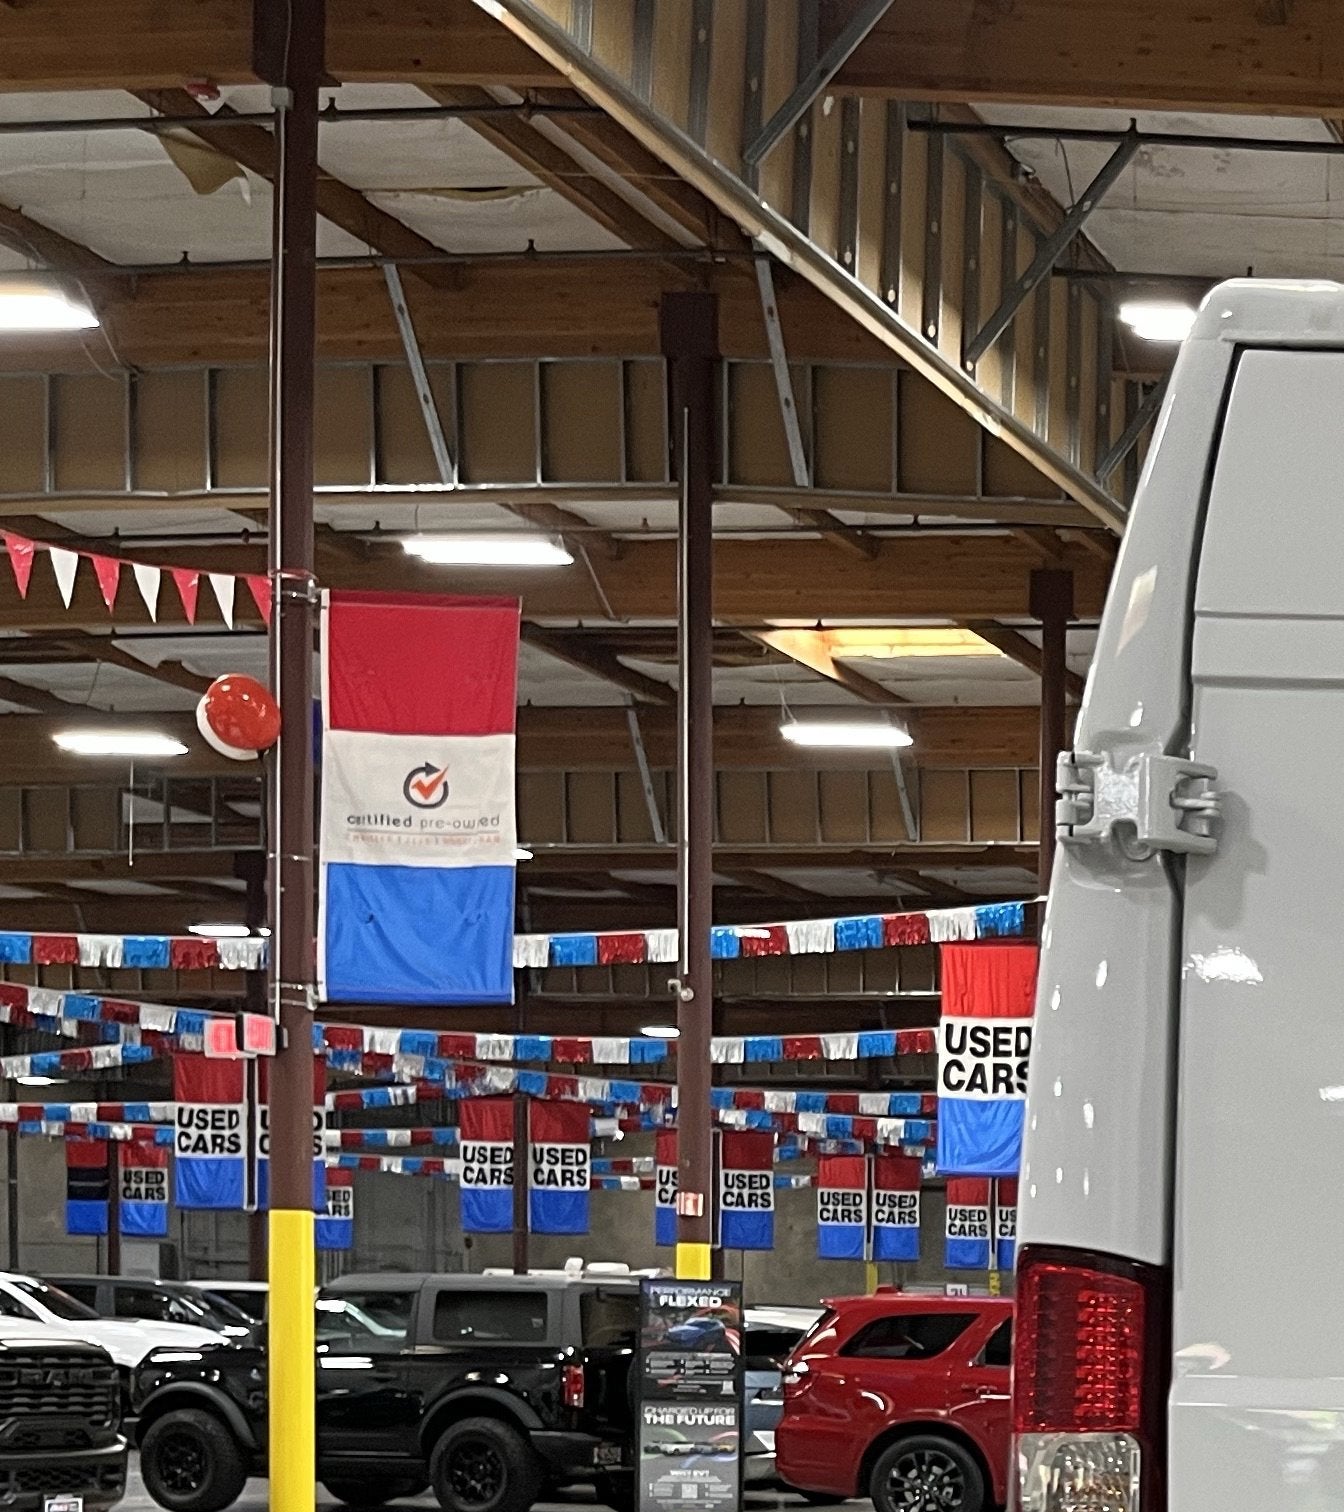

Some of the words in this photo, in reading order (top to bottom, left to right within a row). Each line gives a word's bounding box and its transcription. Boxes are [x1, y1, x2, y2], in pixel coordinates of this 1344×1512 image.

[421, 815, 500, 829] pre-owed
[945, 1023, 1032, 1058] USED
[943, 1059, 1029, 1094] CARS
[178, 1106, 240, 1130] USED
[260, 1109, 323, 1131] UD
[177, 1131, 242, 1154] CARS
[259, 1134, 323, 1156] CS
[463, 1145, 514, 1165] USED
[533, 1147, 587, 1166] USED
[123, 1170, 165, 1185] USED
[462, 1166, 514, 1186] CARS
[533, 1168, 587, 1187] CARS
[659, 1169, 678, 1187] US
[723, 1173, 771, 1190] USED
[122, 1186, 166, 1200] CARS
[658, 1187, 677, 1206] CA
[722, 1191, 772, 1208] CARS
[820, 1191, 862, 1207] USED
[875, 1192, 917, 1209] USED
[819, 1208, 863, 1223] CARS
[875, 1208, 918, 1225] CARS
[948, 1208, 987, 1222] USED
[998, 1209, 1017, 1223] US
[948, 1223, 988, 1238] CARS
[998, 1223, 1017, 1237] CA
[660, 1294, 722, 1308] FLEXED
[644, 1414, 675, 1425] THE
[676, 1414, 736, 1425] FUTURE
